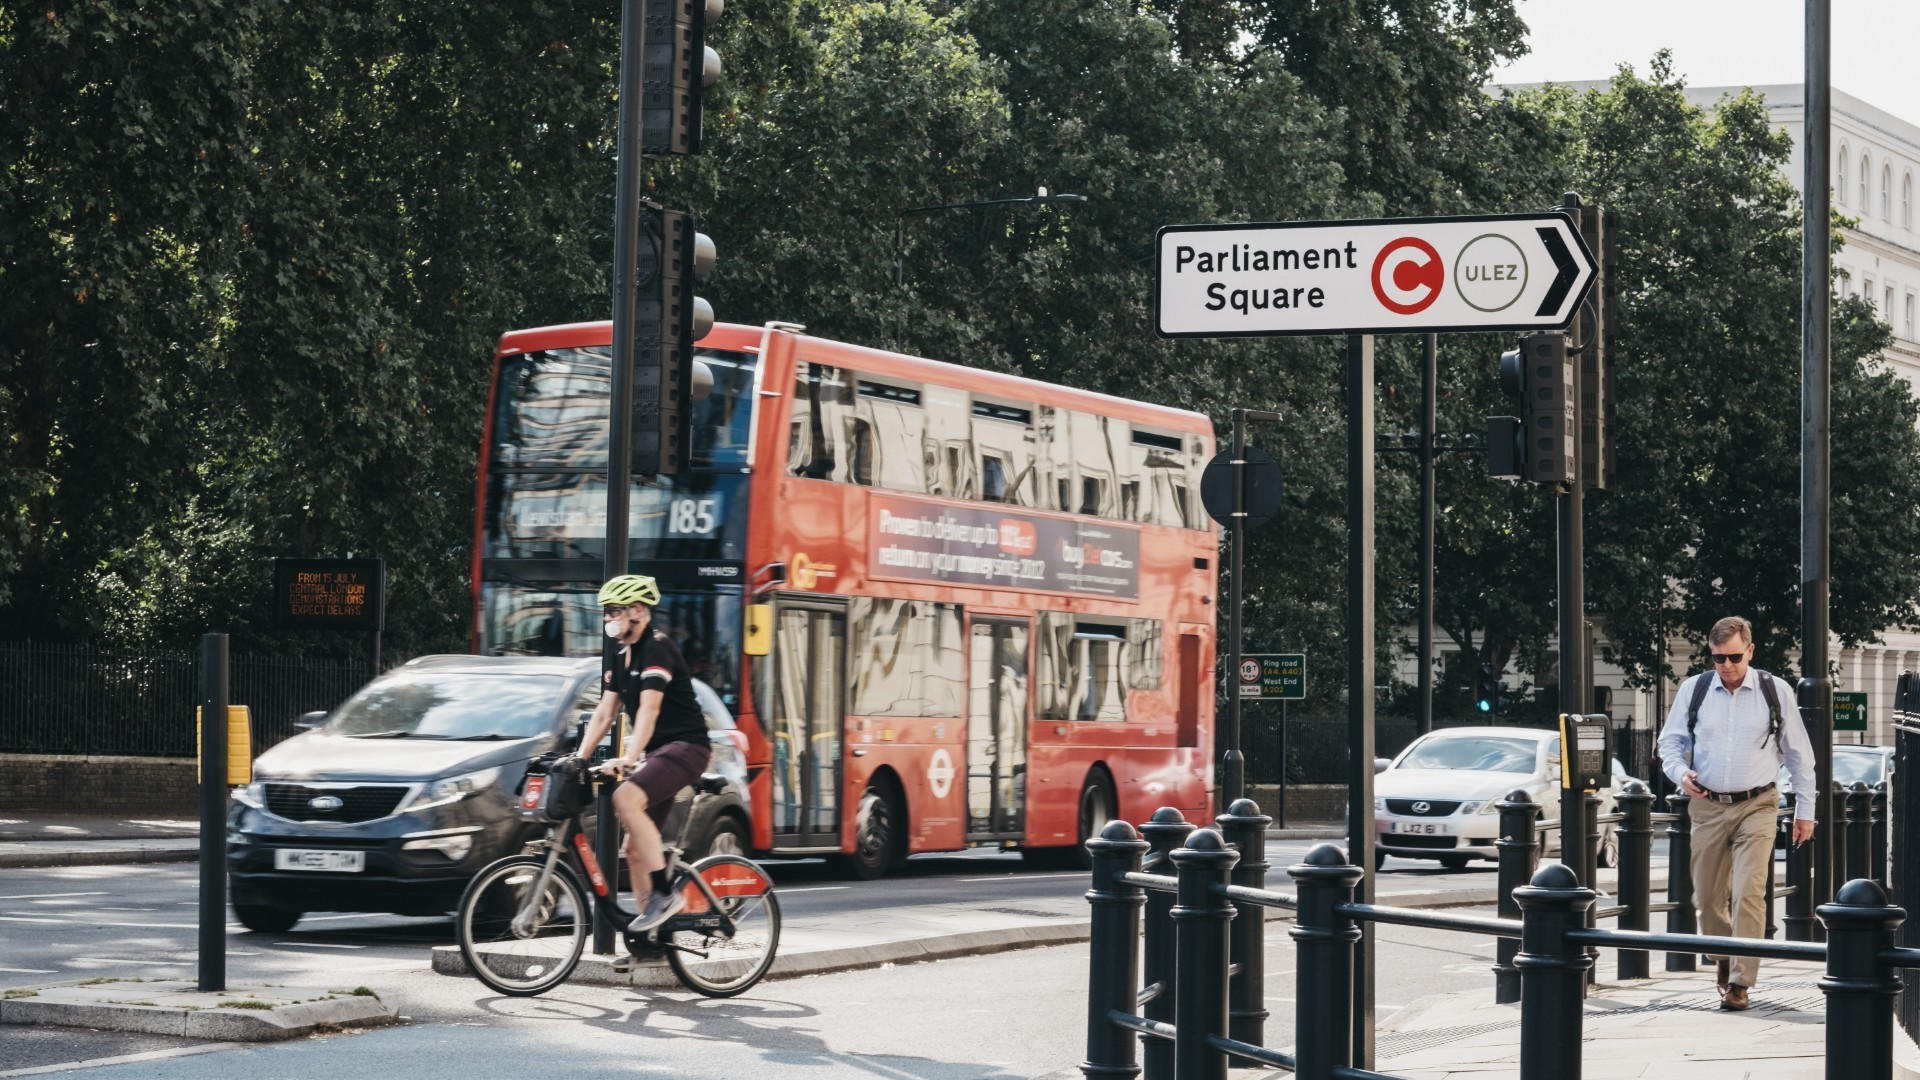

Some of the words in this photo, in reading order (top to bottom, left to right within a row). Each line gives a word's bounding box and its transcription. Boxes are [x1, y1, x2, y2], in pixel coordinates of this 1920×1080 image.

[1176, 241, 1357, 273] Parliament
[1465, 264, 1518, 282] ULEZ
[1204, 282, 1325, 315] Square
[668, 499, 716, 534] 185
[298, 572, 321, 583] FROM
[323, 573, 332, 583] 15
[334, 573, 357, 583] JULY
[289, 583, 328, 594] CENTRAL
[330, 584, 365, 595] LONDON
[289, 594, 365, 605] DEMONSTRATIONS
[292, 604, 324, 615] EXPECT
[327, 605, 361, 616] DELAYS
[1264, 659, 1279, 668] Ring
[1281, 659, 1298, 667] road
[1835, 712, 1850, 720] End
